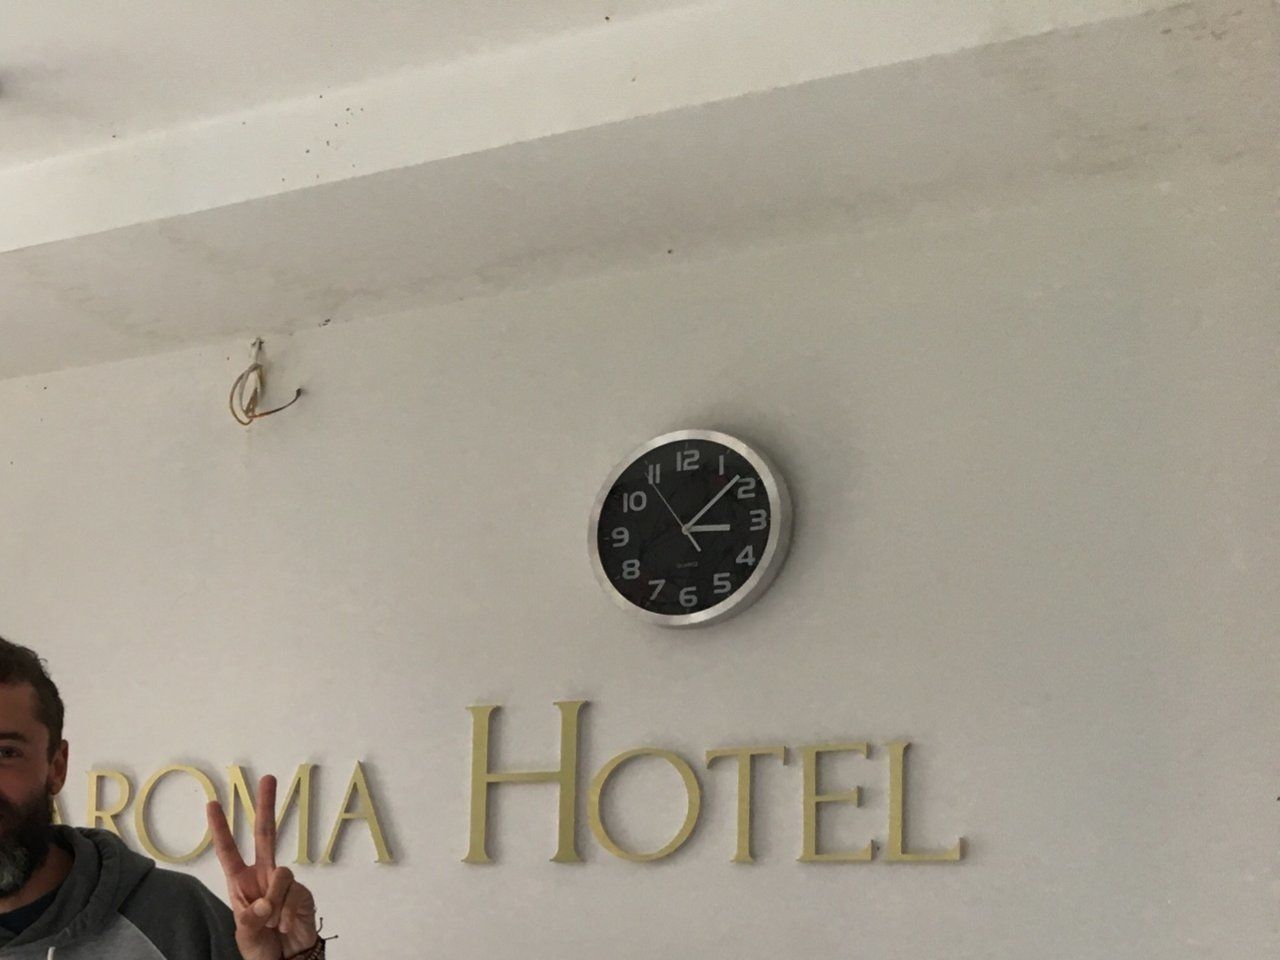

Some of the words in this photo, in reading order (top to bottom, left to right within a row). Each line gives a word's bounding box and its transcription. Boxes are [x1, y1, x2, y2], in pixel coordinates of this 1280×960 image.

[676, 450, 700, 472] 12
[719, 455, 725, 475] 1
[648, 463, 661, 485] 11
[737, 477, 756, 499] 2
[622, 491, 647, 513] 10
[749, 509, 767, 531] 3
[611, 527, 629, 548] 9
[735, 545, 756, 566] 4
[622, 559, 640, 580] 8
[648, 579, 666, 601] 7
[713, 573, 732, 594] 5
[679, 586, 698, 608] 6
[53, 760, 394, 865] ROMA
[461, 700, 963, 864] HOTEL
